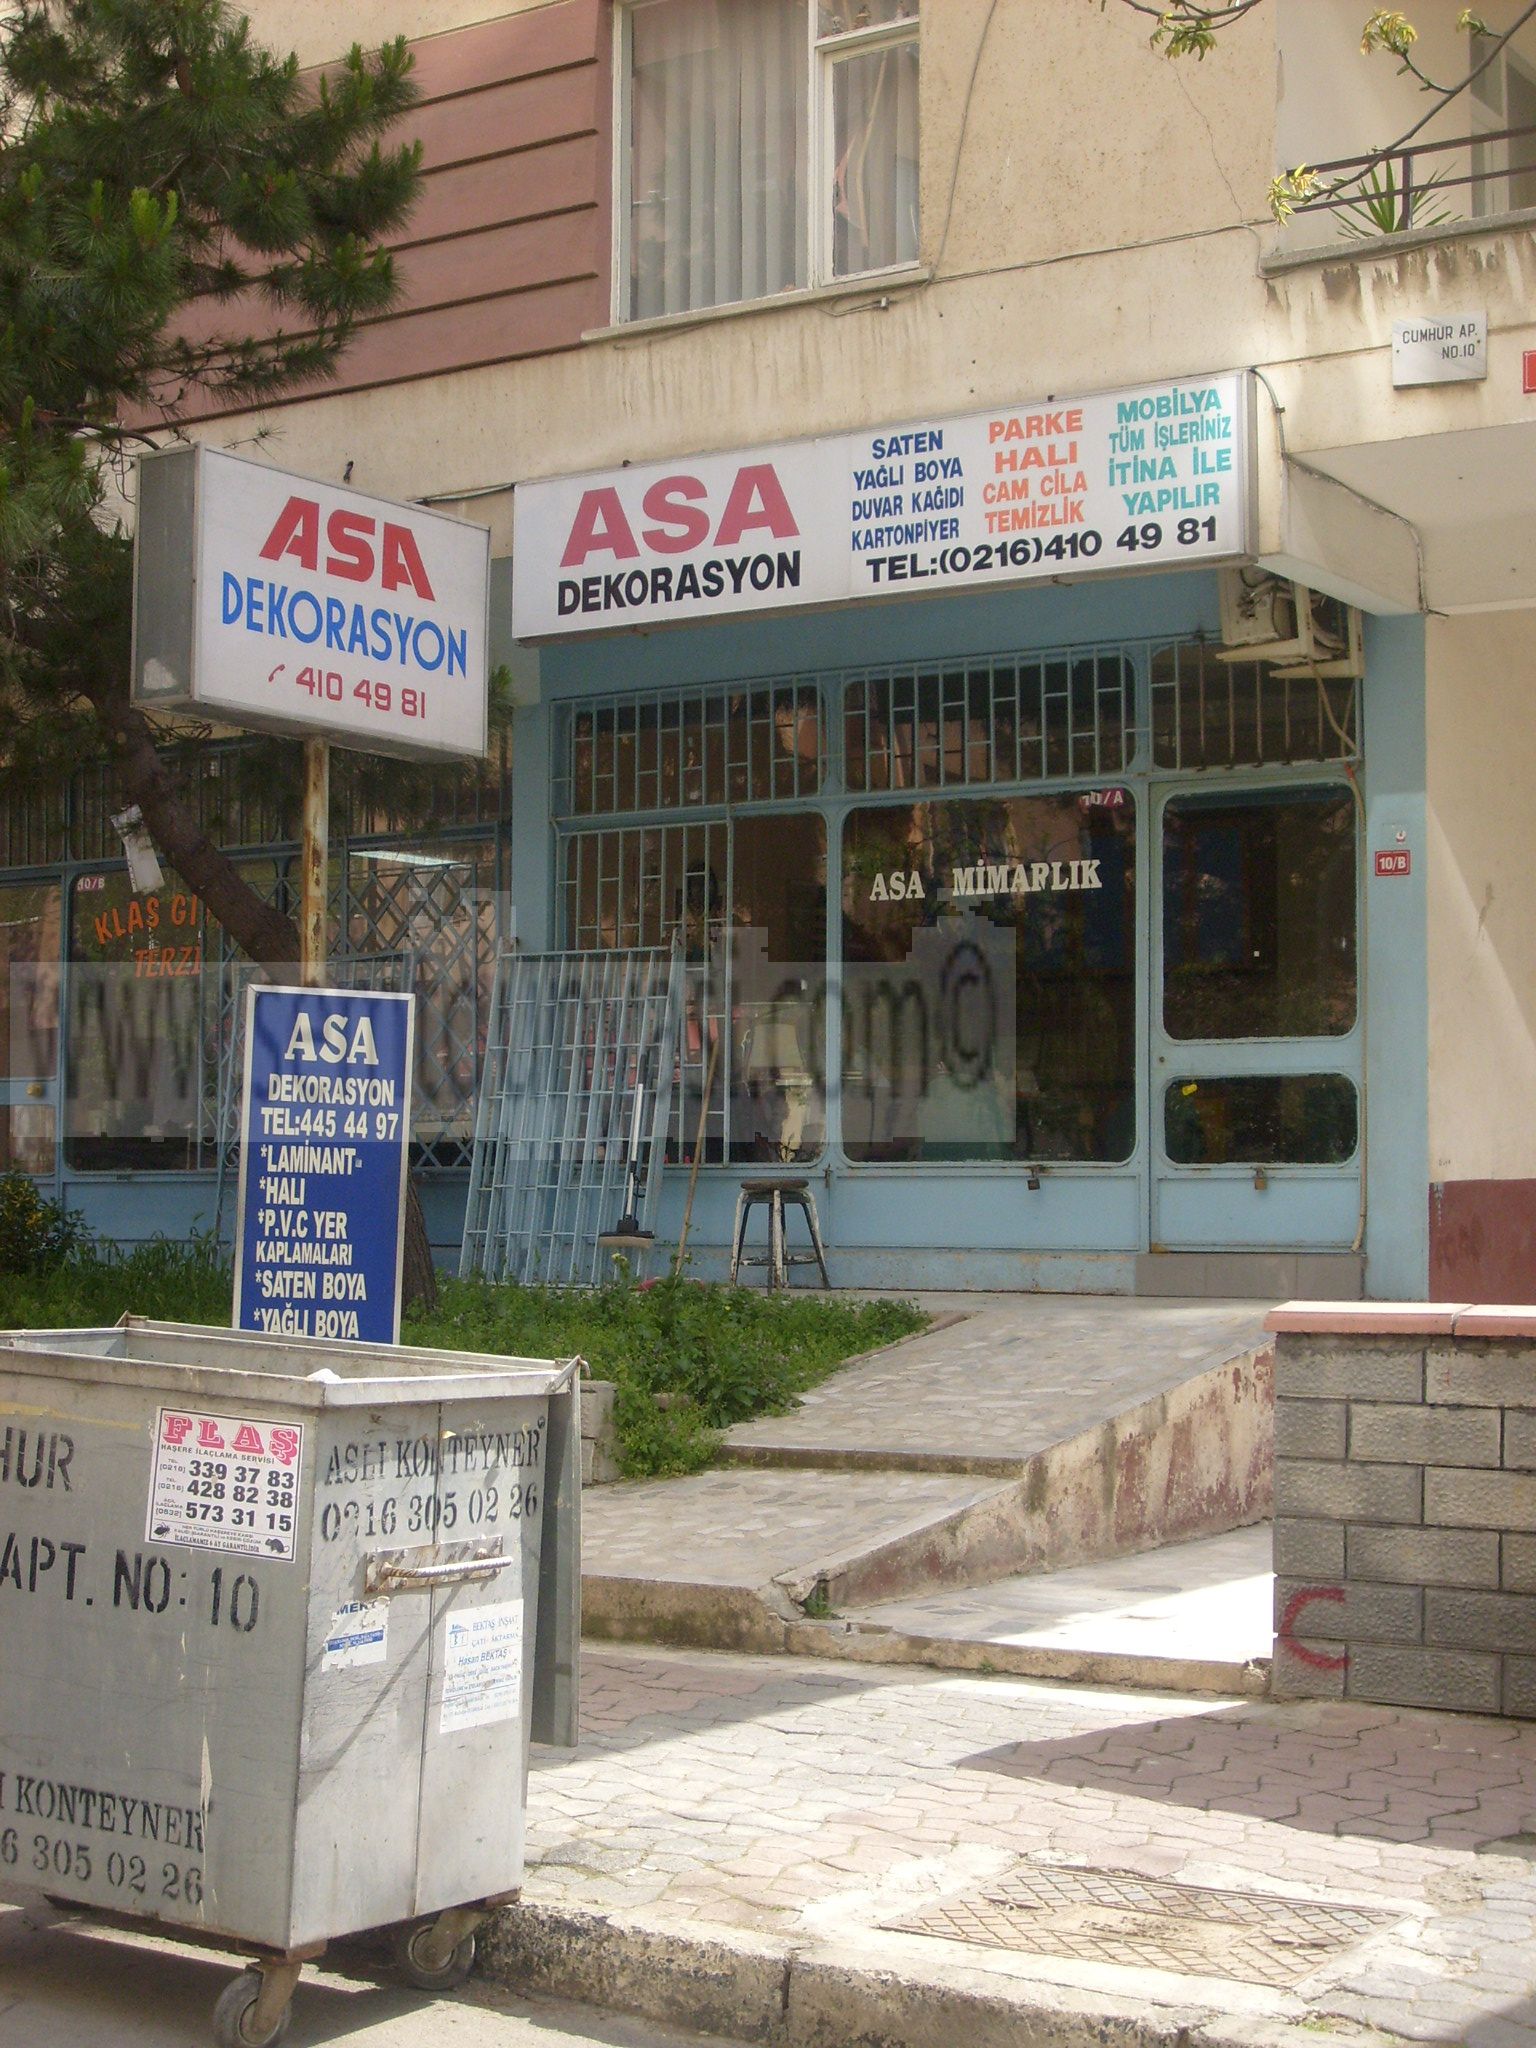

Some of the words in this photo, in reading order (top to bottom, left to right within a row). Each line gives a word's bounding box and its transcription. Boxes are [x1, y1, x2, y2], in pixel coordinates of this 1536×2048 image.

[1402, 326, 1453, 344] CUMHUR
[1459, 323, 1478, 338] AP.
[1442, 344, 1475, 359] NO.10
[1117, 388, 1222, 424] MOBİLYA
[989, 408, 1083, 444] PARKE
[1109, 430, 1145, 454] TÜM
[1154, 416, 1231, 452] İŞLERİNİZ
[872, 430, 943, 460] SATEN
[995, 441, 1078, 474] HALI
[853, 464, 903, 491] YAĞLI
[914, 456, 963, 483] BOYA
[1109, 455, 1177, 487] İTİNA
[1193, 446, 1232, 475] İLE
[852, 494, 903, 521] DUVAR
[912, 486, 964, 513] KAĞIDI
[983, 479, 1030, 505] CAM
[1041, 468, 1088, 495] CİLA
[1121, 482, 1220, 516] YAPILIR
[559, 462, 800, 568] ASA
[985, 496, 1085, 534] TEMİZLİK
[259, 496, 436, 602] ASA
[852, 517, 959, 552] KARTONPİYER
[1116, 522, 1162, 552] 49
[1177, 515, 1217, 546] 81
[557, 550, 800, 616] DEKORASYON
[222, 571, 467, 679] DEKORASYON
[296, 667, 343, 702] 410
[353, 679, 391, 712] 49
[401, 688, 426, 719] 81
[869, 871, 926, 901] ASA
[952, 859, 1102, 897] MİMARLIK
[1379, 856, 1406, 870] 10/B
[95, 896, 160, 944] KLAS
[284, 1012, 379, 1065] ASA
[268, 1073, 395, 1106] DEKORASYON
[261, 1107, 336, 1138] TEL:445
[344, 1111, 368, 1139] 44
[375, 1113, 398, 1140] 97
[314, 1211, 347, 1240] YER
[256, 1241, 353, 1266] KAPLAMALARI
[323, 1273, 367, 1301] BOYA
[315, 1309, 360, 1339] BOYA
[161, 1444, 192, 1453] HAŞERE
[163, 1414, 298, 1466] FLAŞ
[189, 1460, 227, 1480] 339
[234, 1466, 260, 1484] 37
[267, 1471, 294, 1489] 83
[187, 1480, 226, 1500] 428
[233, 1485, 259, 1504] 82
[266, 1490, 293, 1509] 38
[322, 1497, 397, 1542] 0216
[408, 1492, 457, 1532] 305
[468, 1486, 499, 1524] 02
[509, 1482, 538, 1520] 26
[186, 1502, 224, 1522] 573
[231, 1508, 255, 1527] 31
[266, 1513, 292, 1532] 15
[114, 1549, 187, 1613] NO:
[211, 1567, 259, 1632] 10
[33, 1834, 92, 1881] 305
[107, 1852, 146, 1894] 02
[162, 1862, 203, 1905] 26
